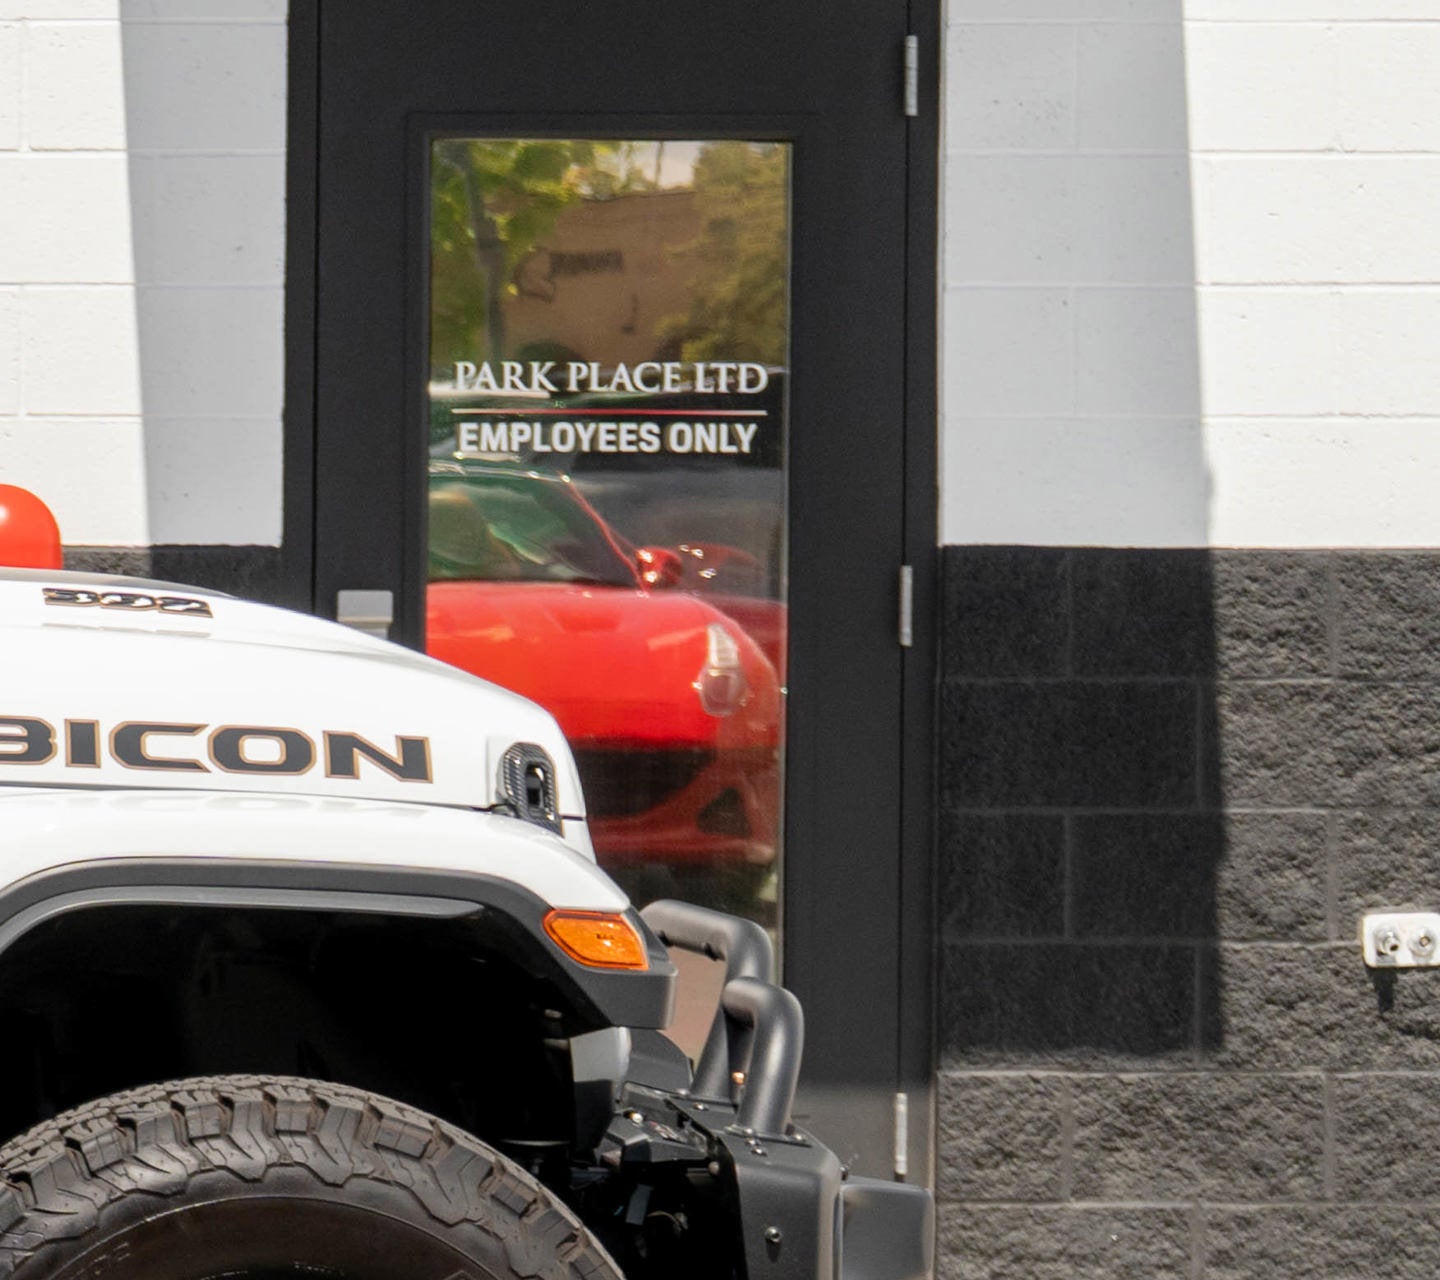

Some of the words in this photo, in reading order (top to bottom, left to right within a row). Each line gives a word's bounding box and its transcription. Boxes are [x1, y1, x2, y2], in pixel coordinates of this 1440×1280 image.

[453, 361, 557, 394] PARK
[568, 362, 681, 394] PLACE
[694, 362, 769, 394] LTD
[459, 422, 662, 453] EMPLOYEES
[669, 423, 758, 453] ONLY
